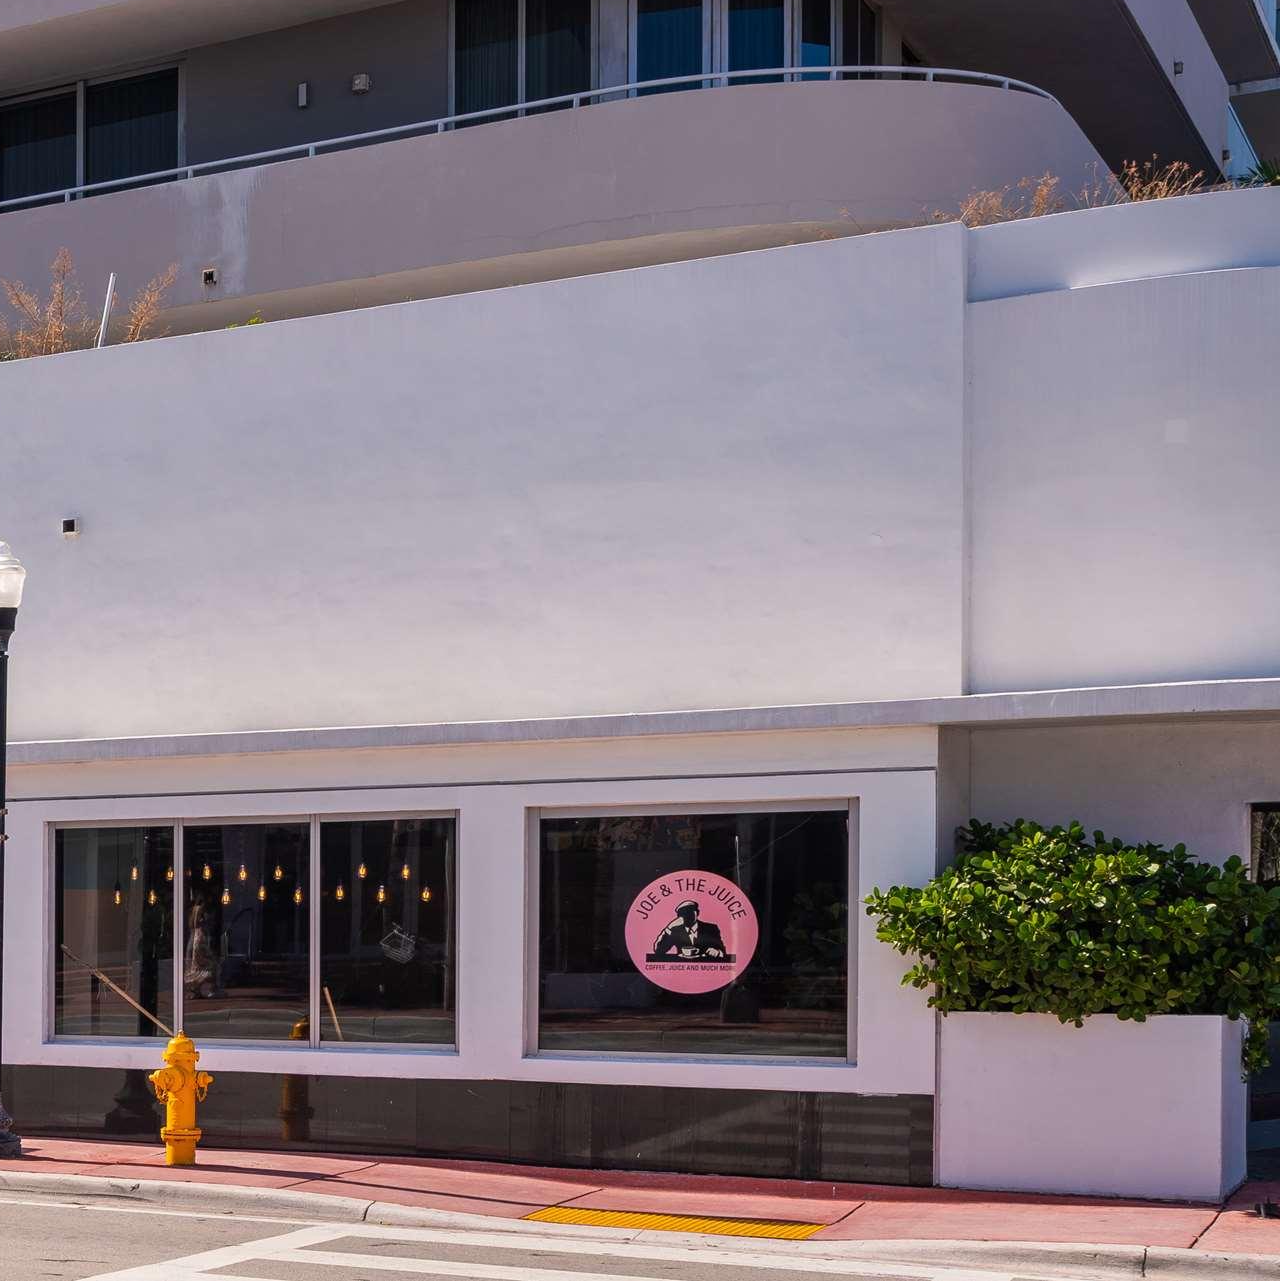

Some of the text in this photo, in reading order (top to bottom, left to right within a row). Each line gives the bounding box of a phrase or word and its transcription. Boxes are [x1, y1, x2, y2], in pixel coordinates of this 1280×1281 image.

[636, 878, 748, 920] JOE & THE JUICE
